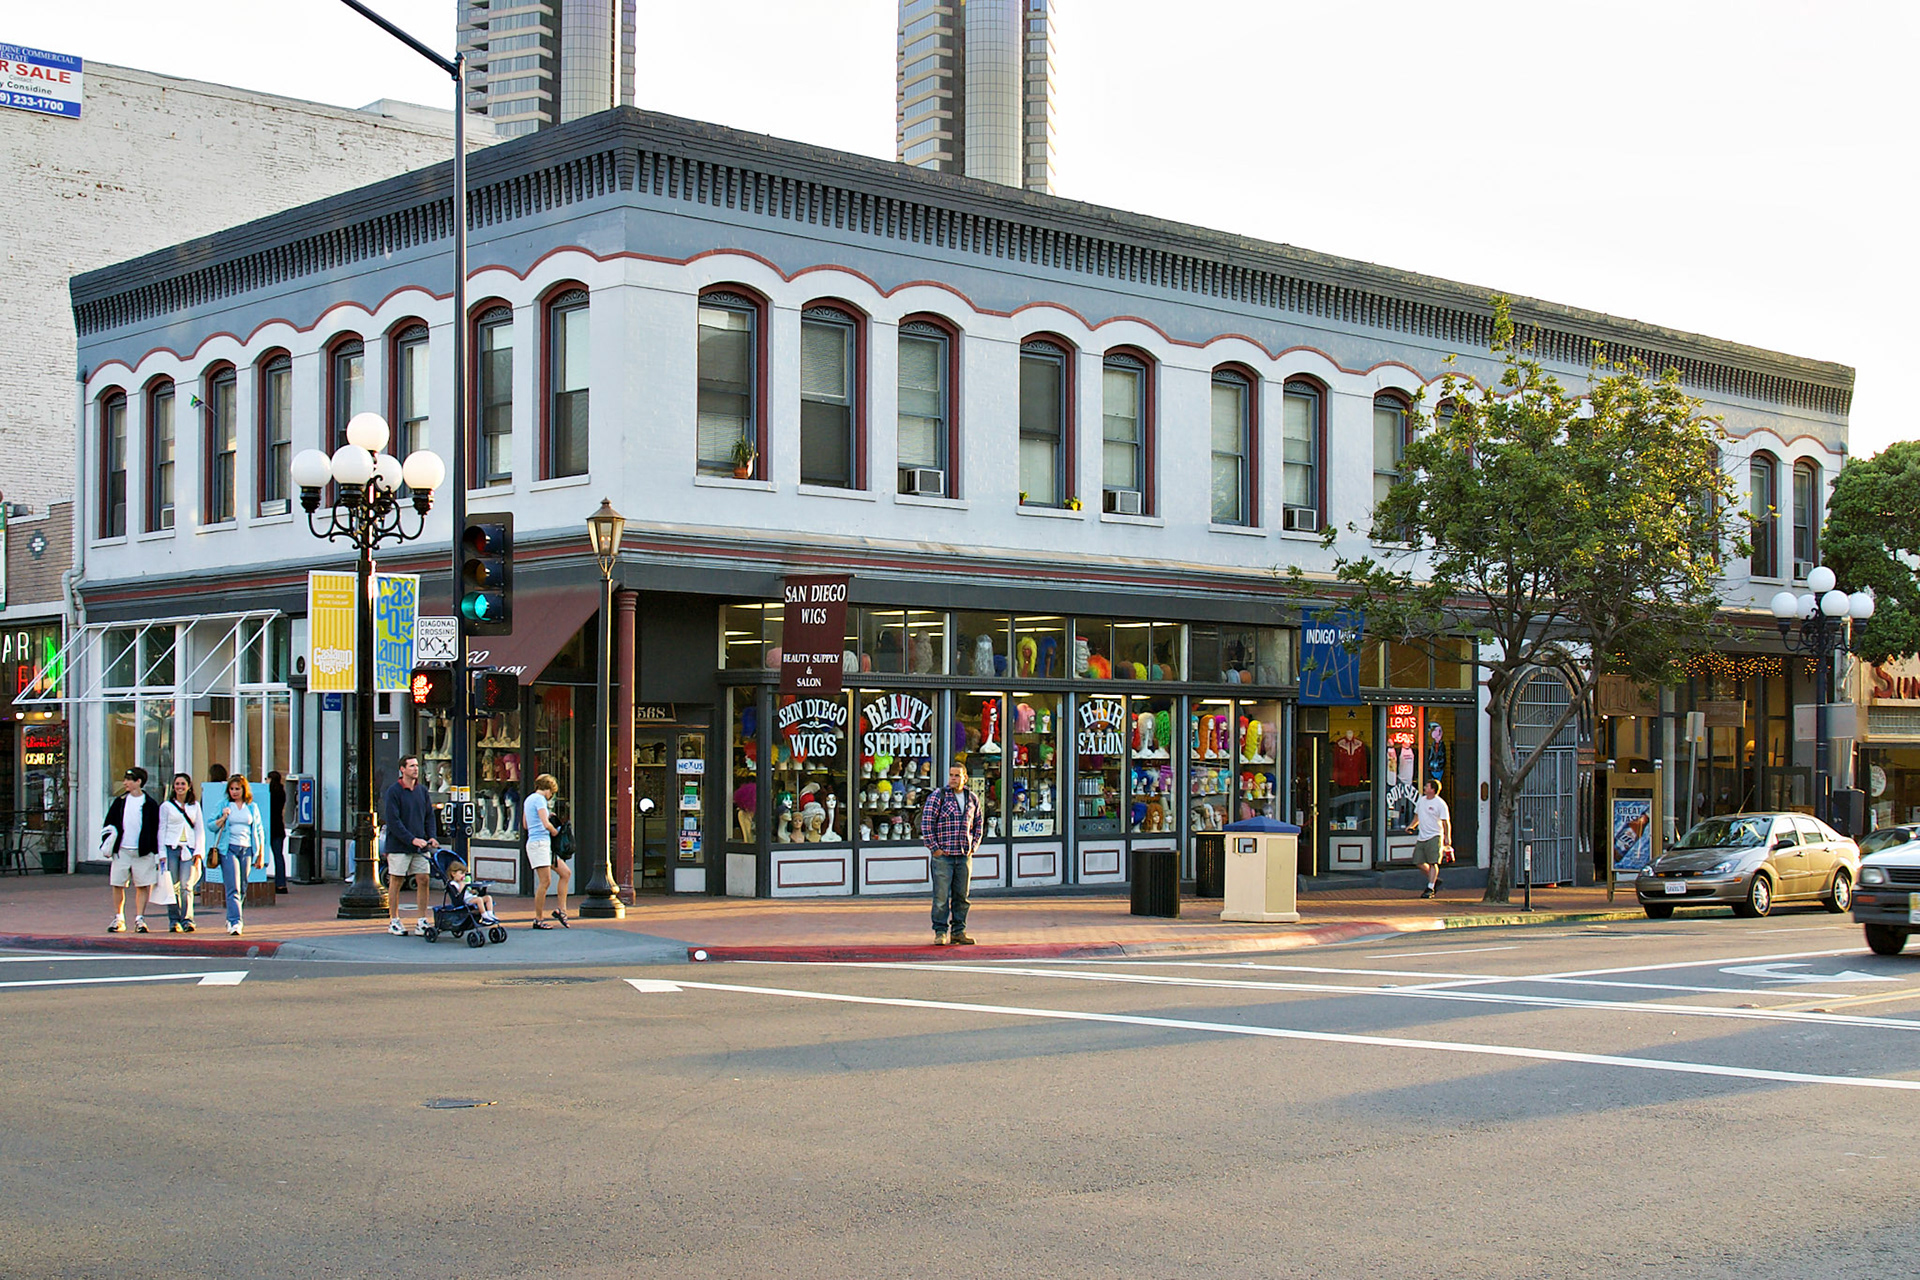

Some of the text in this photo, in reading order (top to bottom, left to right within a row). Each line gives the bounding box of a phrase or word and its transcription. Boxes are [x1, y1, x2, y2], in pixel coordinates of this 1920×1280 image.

[1, 52, 28, 63] ESTATE
[22, 48, 75, 65] COMMERCIAL
[16, 64, 71, 84] SALE
[7, 81, 52, 95] Considine
[13, 94, 64, 111] 233-1700
[785, 584, 846, 603] SAN DIEGO
[420, 620, 455, 628] DIAGONAL
[801, 608, 827, 624] WIGS
[419, 637, 435, 651] OK
[1306, 629, 1335, 645] INDIGO
[783, 654, 840, 663] BEAUTY SUPPLY
[806, 666, 812, 675] &
[797, 678, 822, 687] SALON
[637, 706, 666, 719] 568
[778, 698, 847, 729] SAN DIEGO
[863, 693, 933, 731] BEAUTY
[1079, 699, 1125, 730] HAIR
[1394, 703, 1413, 716] USED
[789, 733, 837, 758] WIGS
[864, 732, 933, 758] SUPPLY
[1078, 732, 1125, 755] SALON
[1386, 783, 1419, 807] BUY SEL
[1617, 806, 1641, 815] GREAT
